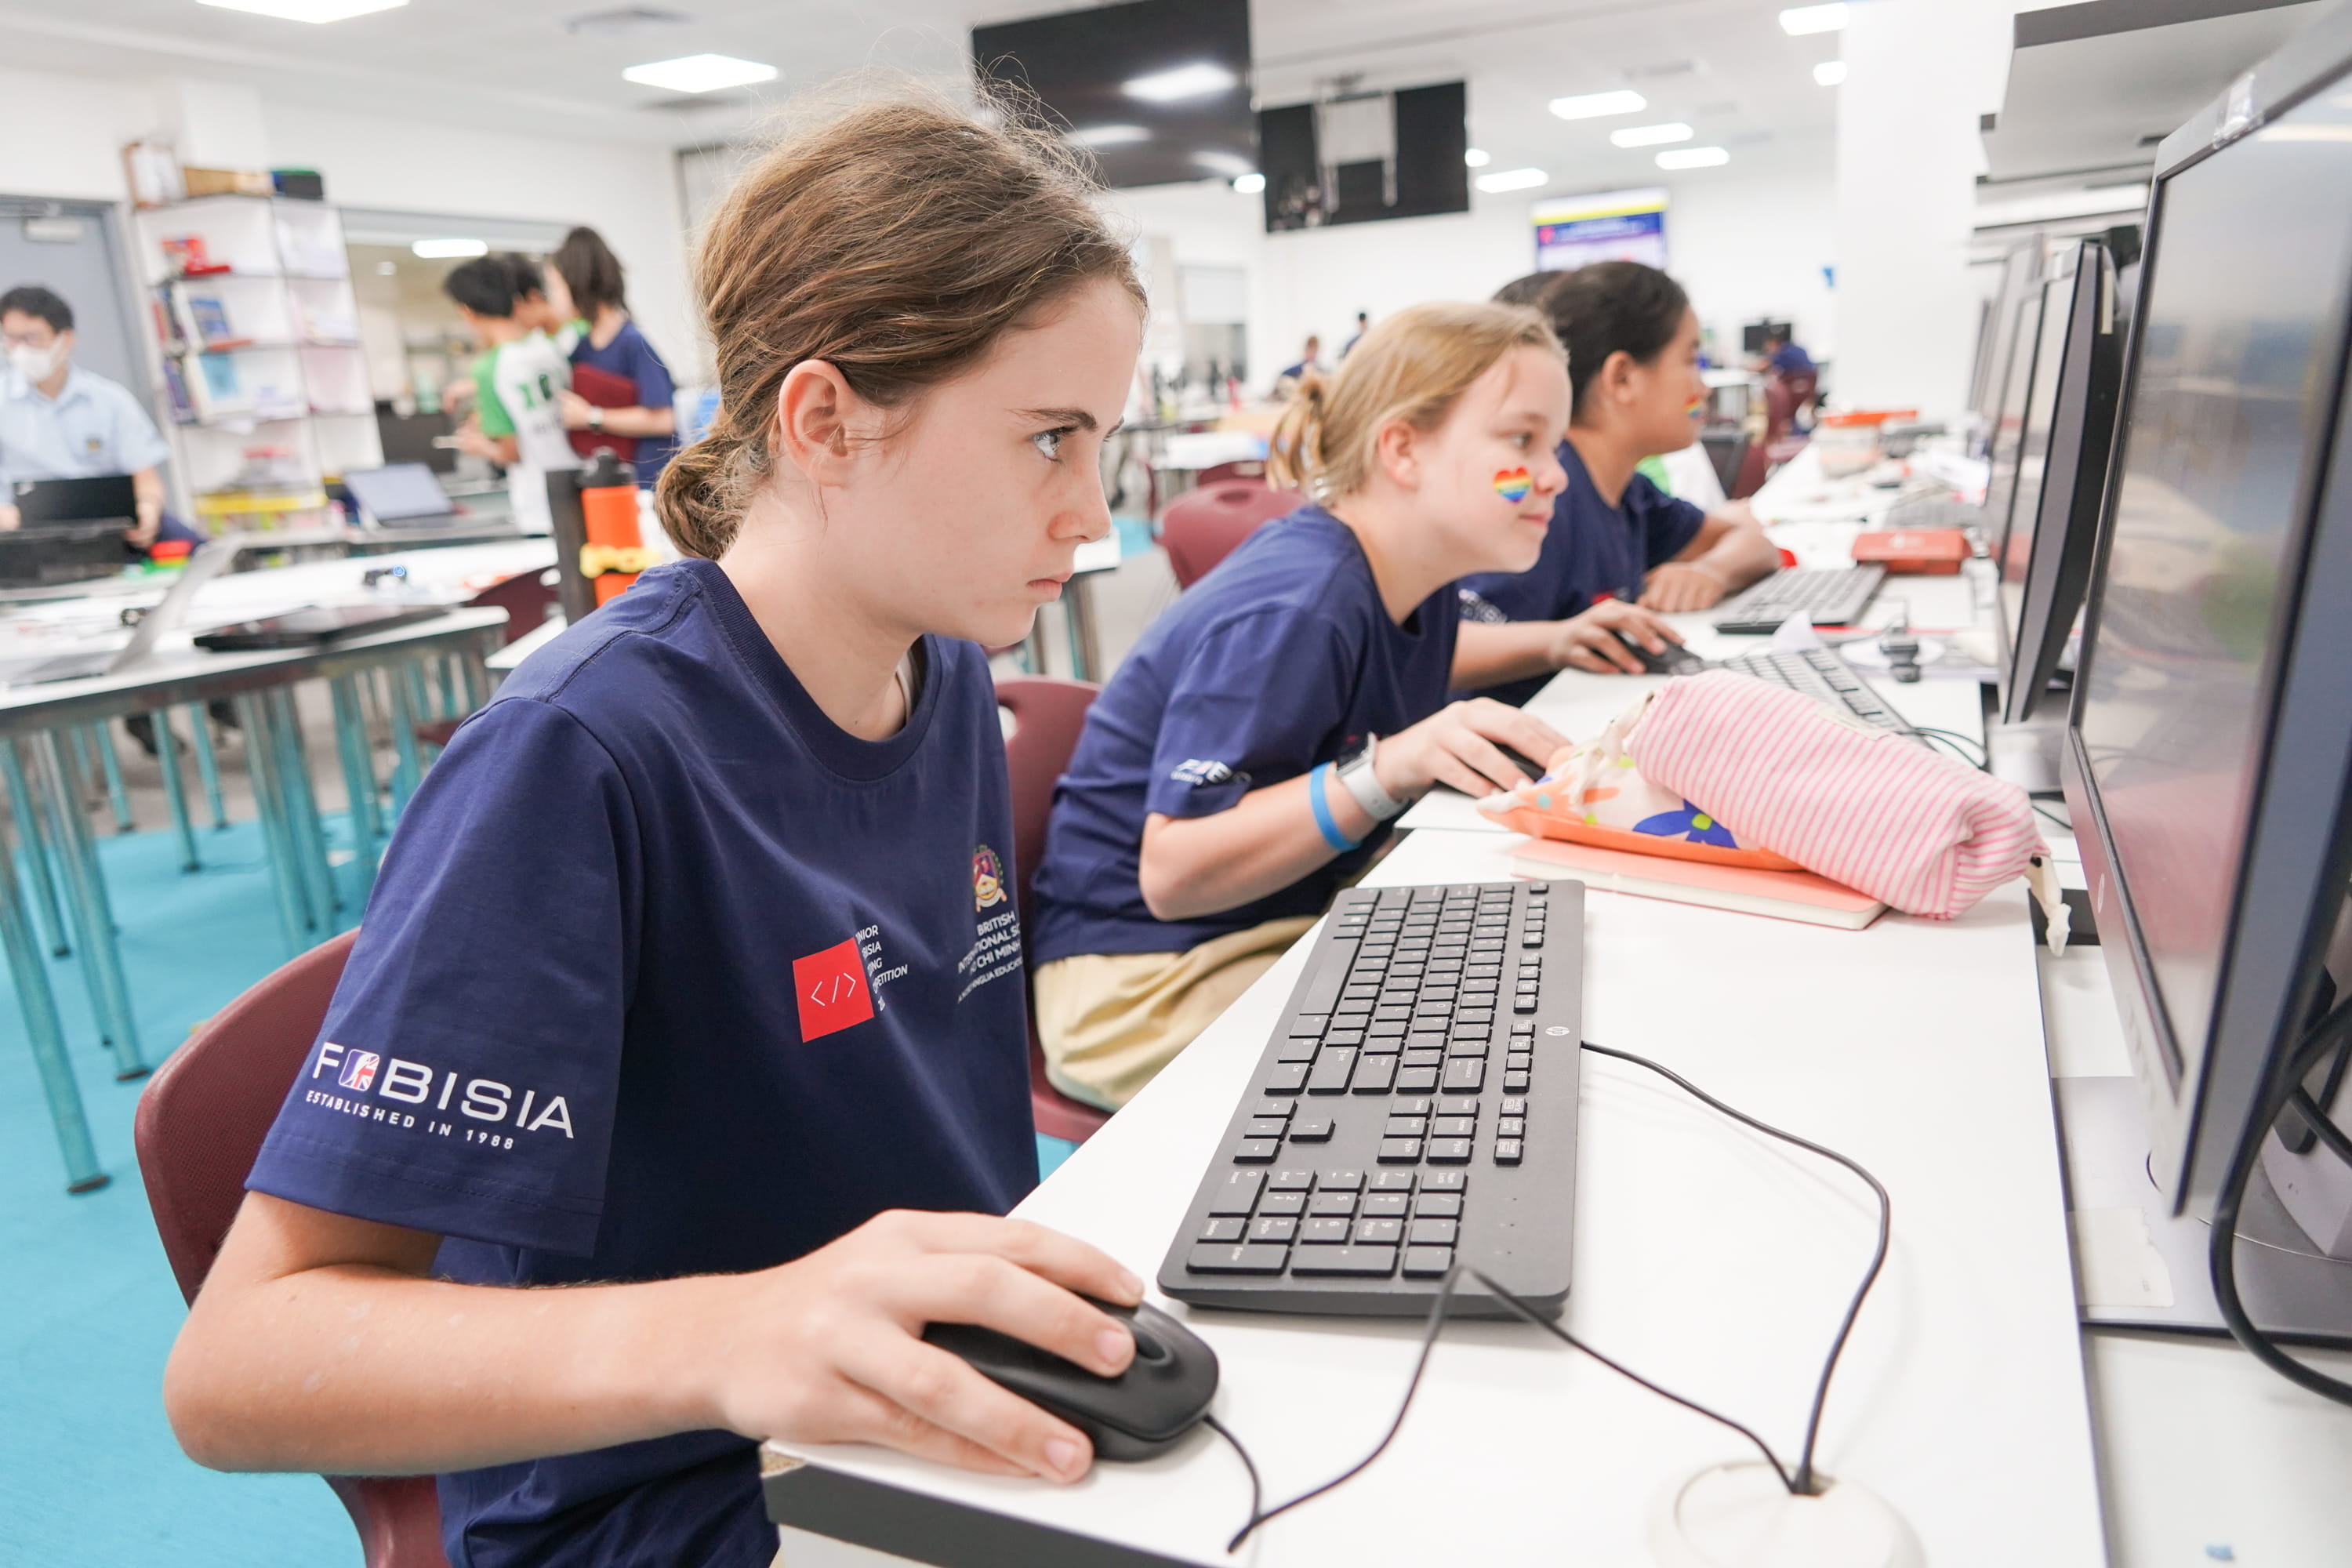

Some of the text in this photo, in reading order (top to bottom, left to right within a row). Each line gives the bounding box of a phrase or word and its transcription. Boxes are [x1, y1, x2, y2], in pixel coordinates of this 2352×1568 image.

[977, 910, 1016, 936] BRITISH
[977, 951, 994, 968] CHI
[305, 1089, 514, 1151] ESTABLISHED IN 1988
[1231, 1247, 1243, 1261] Enter
